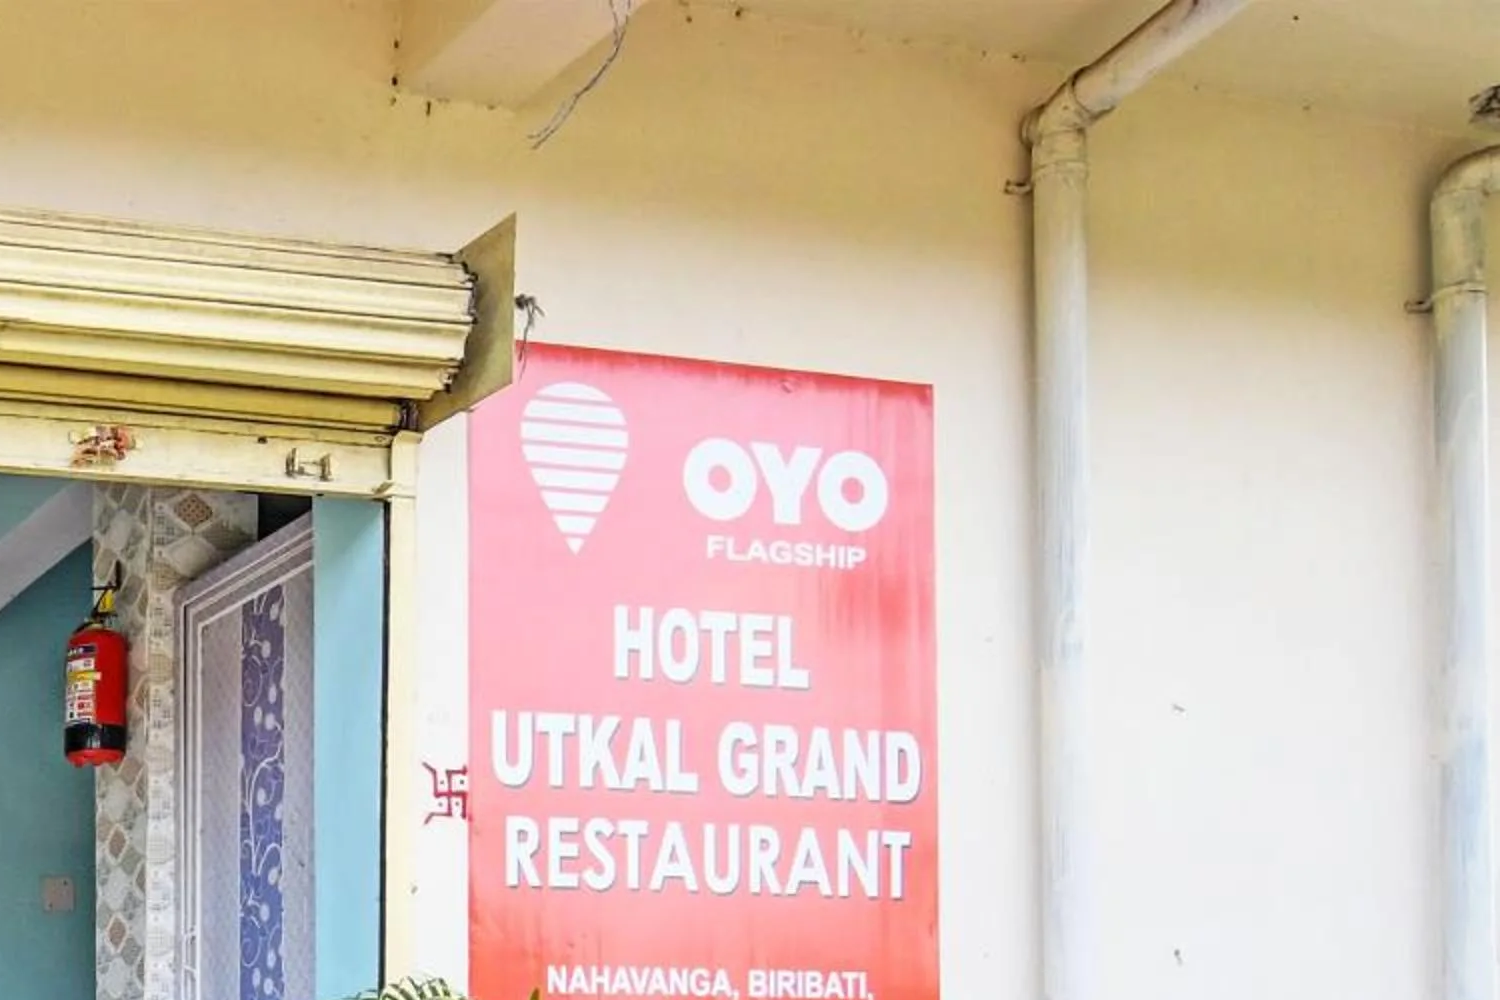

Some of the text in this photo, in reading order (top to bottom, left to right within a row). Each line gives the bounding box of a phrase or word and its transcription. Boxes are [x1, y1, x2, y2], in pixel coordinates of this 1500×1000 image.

[683, 438, 889, 532] OYO
[706, 535, 867, 570] FLAGSHIP
[613, 605, 811, 690] HOTEL
[490, 709, 922, 803] UTKAL GRAND
[504, 815, 912, 899] RESTAURANT
